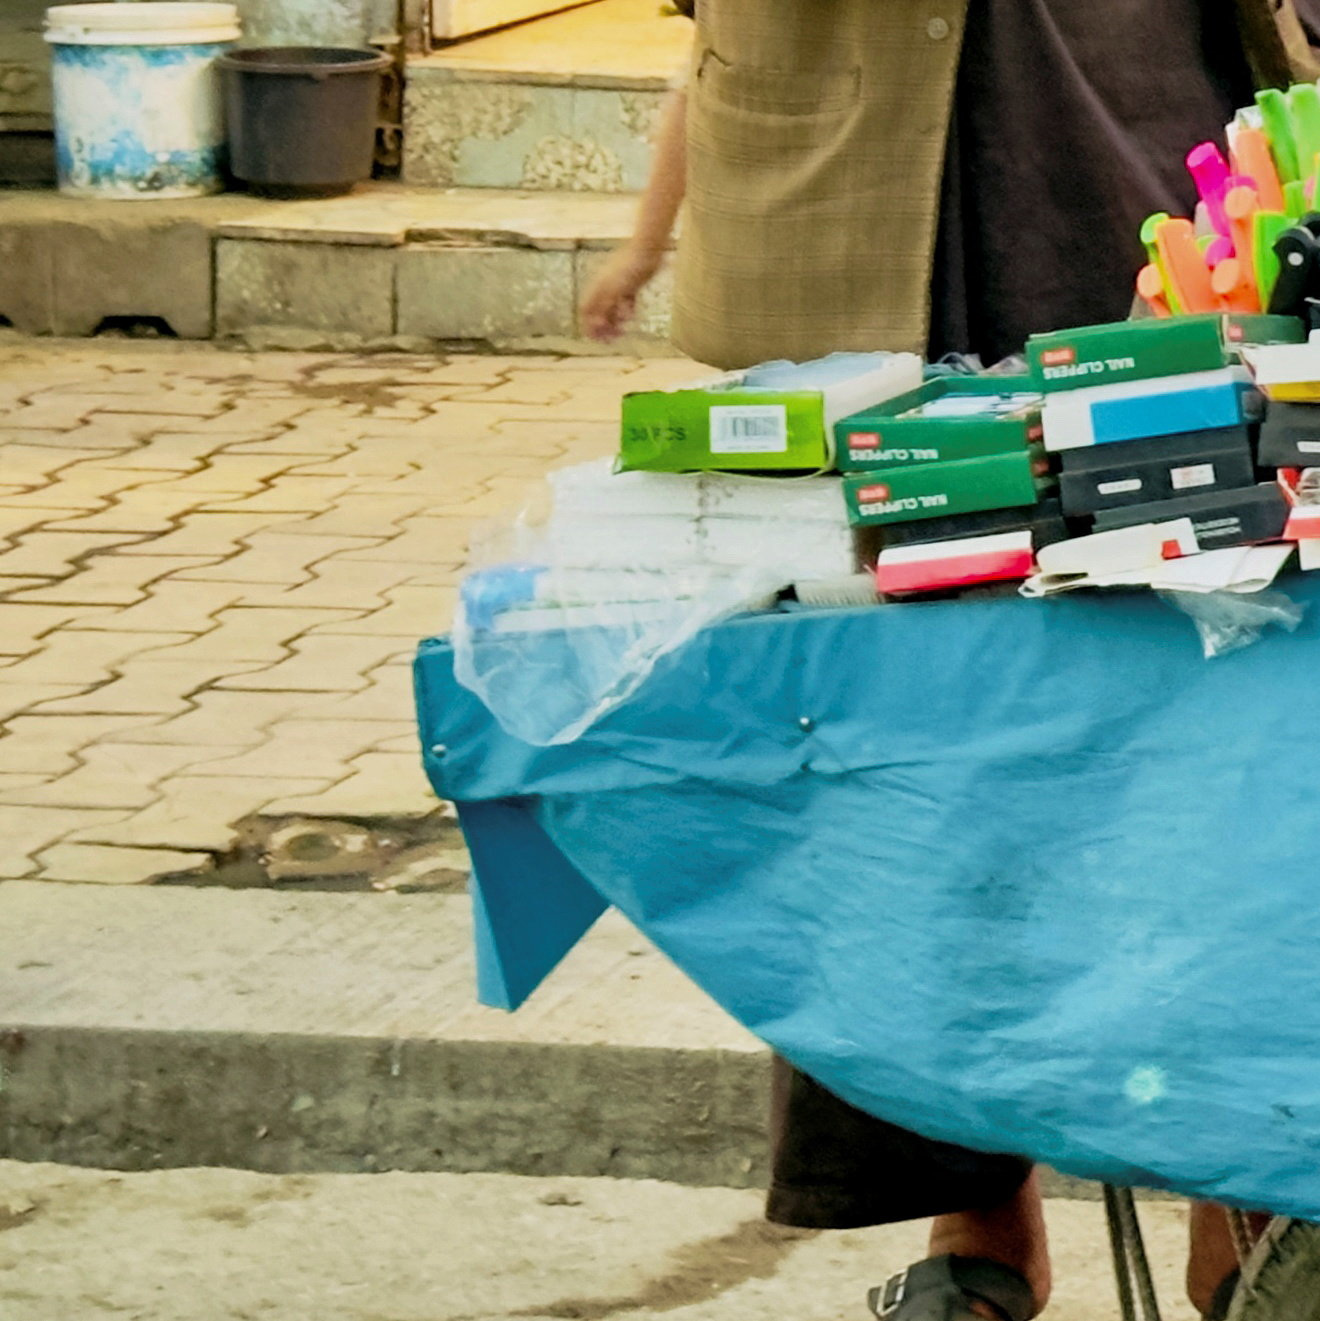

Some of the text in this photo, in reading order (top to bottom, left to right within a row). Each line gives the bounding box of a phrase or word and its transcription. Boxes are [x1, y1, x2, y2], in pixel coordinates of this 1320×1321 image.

[1042, 357, 1136, 380] NAIL CLIPPERS
[848, 448, 940, 463] NAIL CLIPPERS
[857, 493, 949, 517] NAIL CLIPPERS
